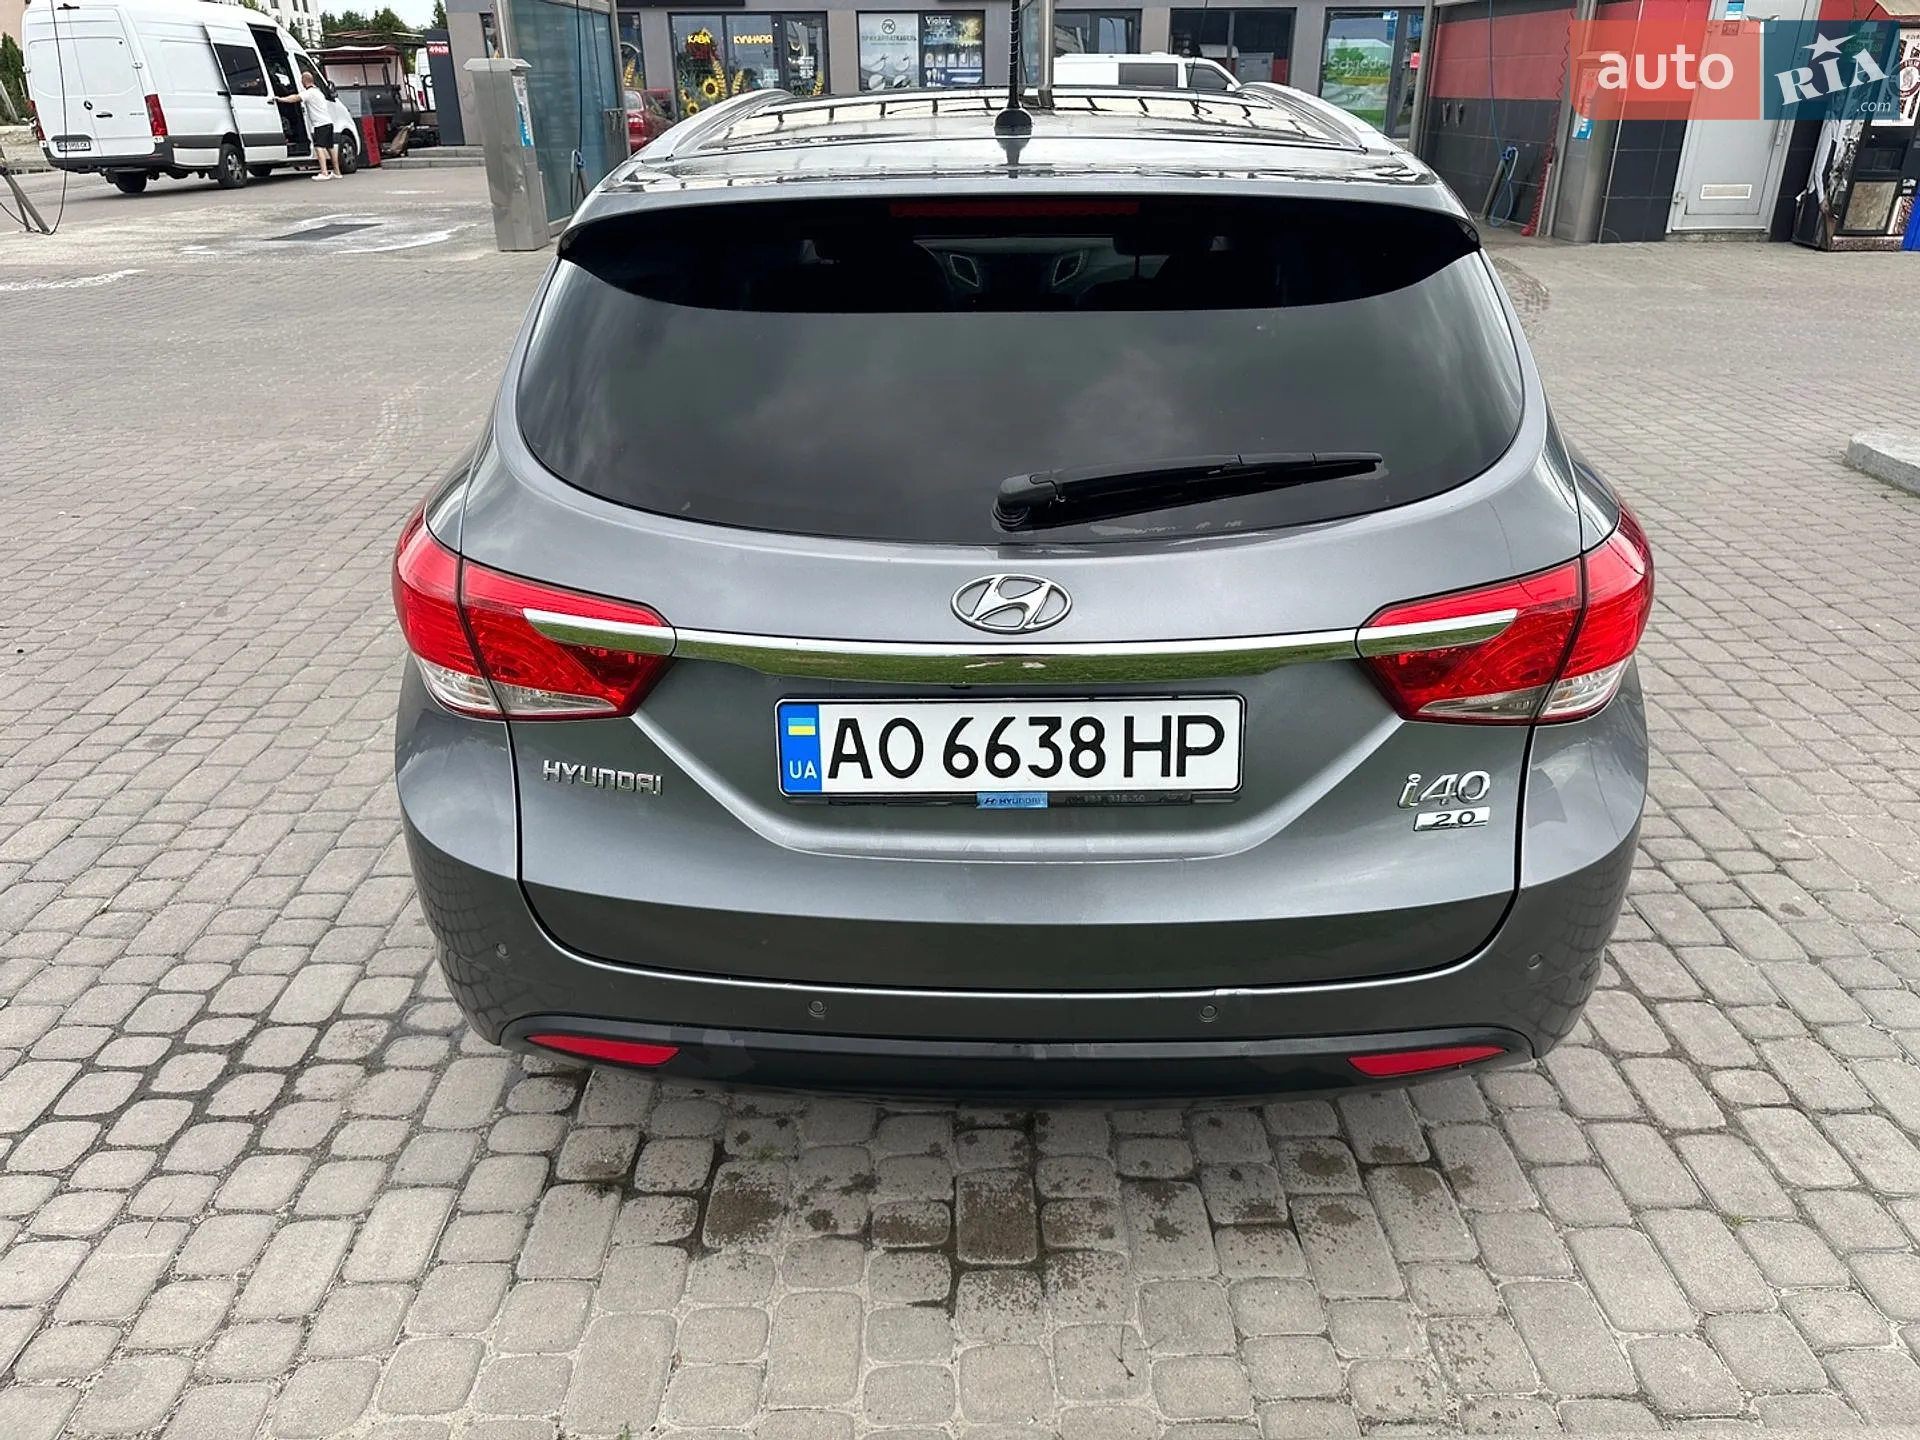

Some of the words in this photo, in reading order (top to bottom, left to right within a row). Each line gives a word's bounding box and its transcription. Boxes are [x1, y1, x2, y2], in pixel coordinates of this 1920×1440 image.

[688, 34, 711, 44] КАВА
[828, 717, 924, 779] AO
[943, 716, 1107, 779] 6638
[1123, 714, 1225, 778] HP
[543, 759, 663, 796] HYUNDAI
[789, 760, 818, 779] UA
[1398, 770, 1491, 808] i40
[1434, 811, 1476, 828] 2.0
